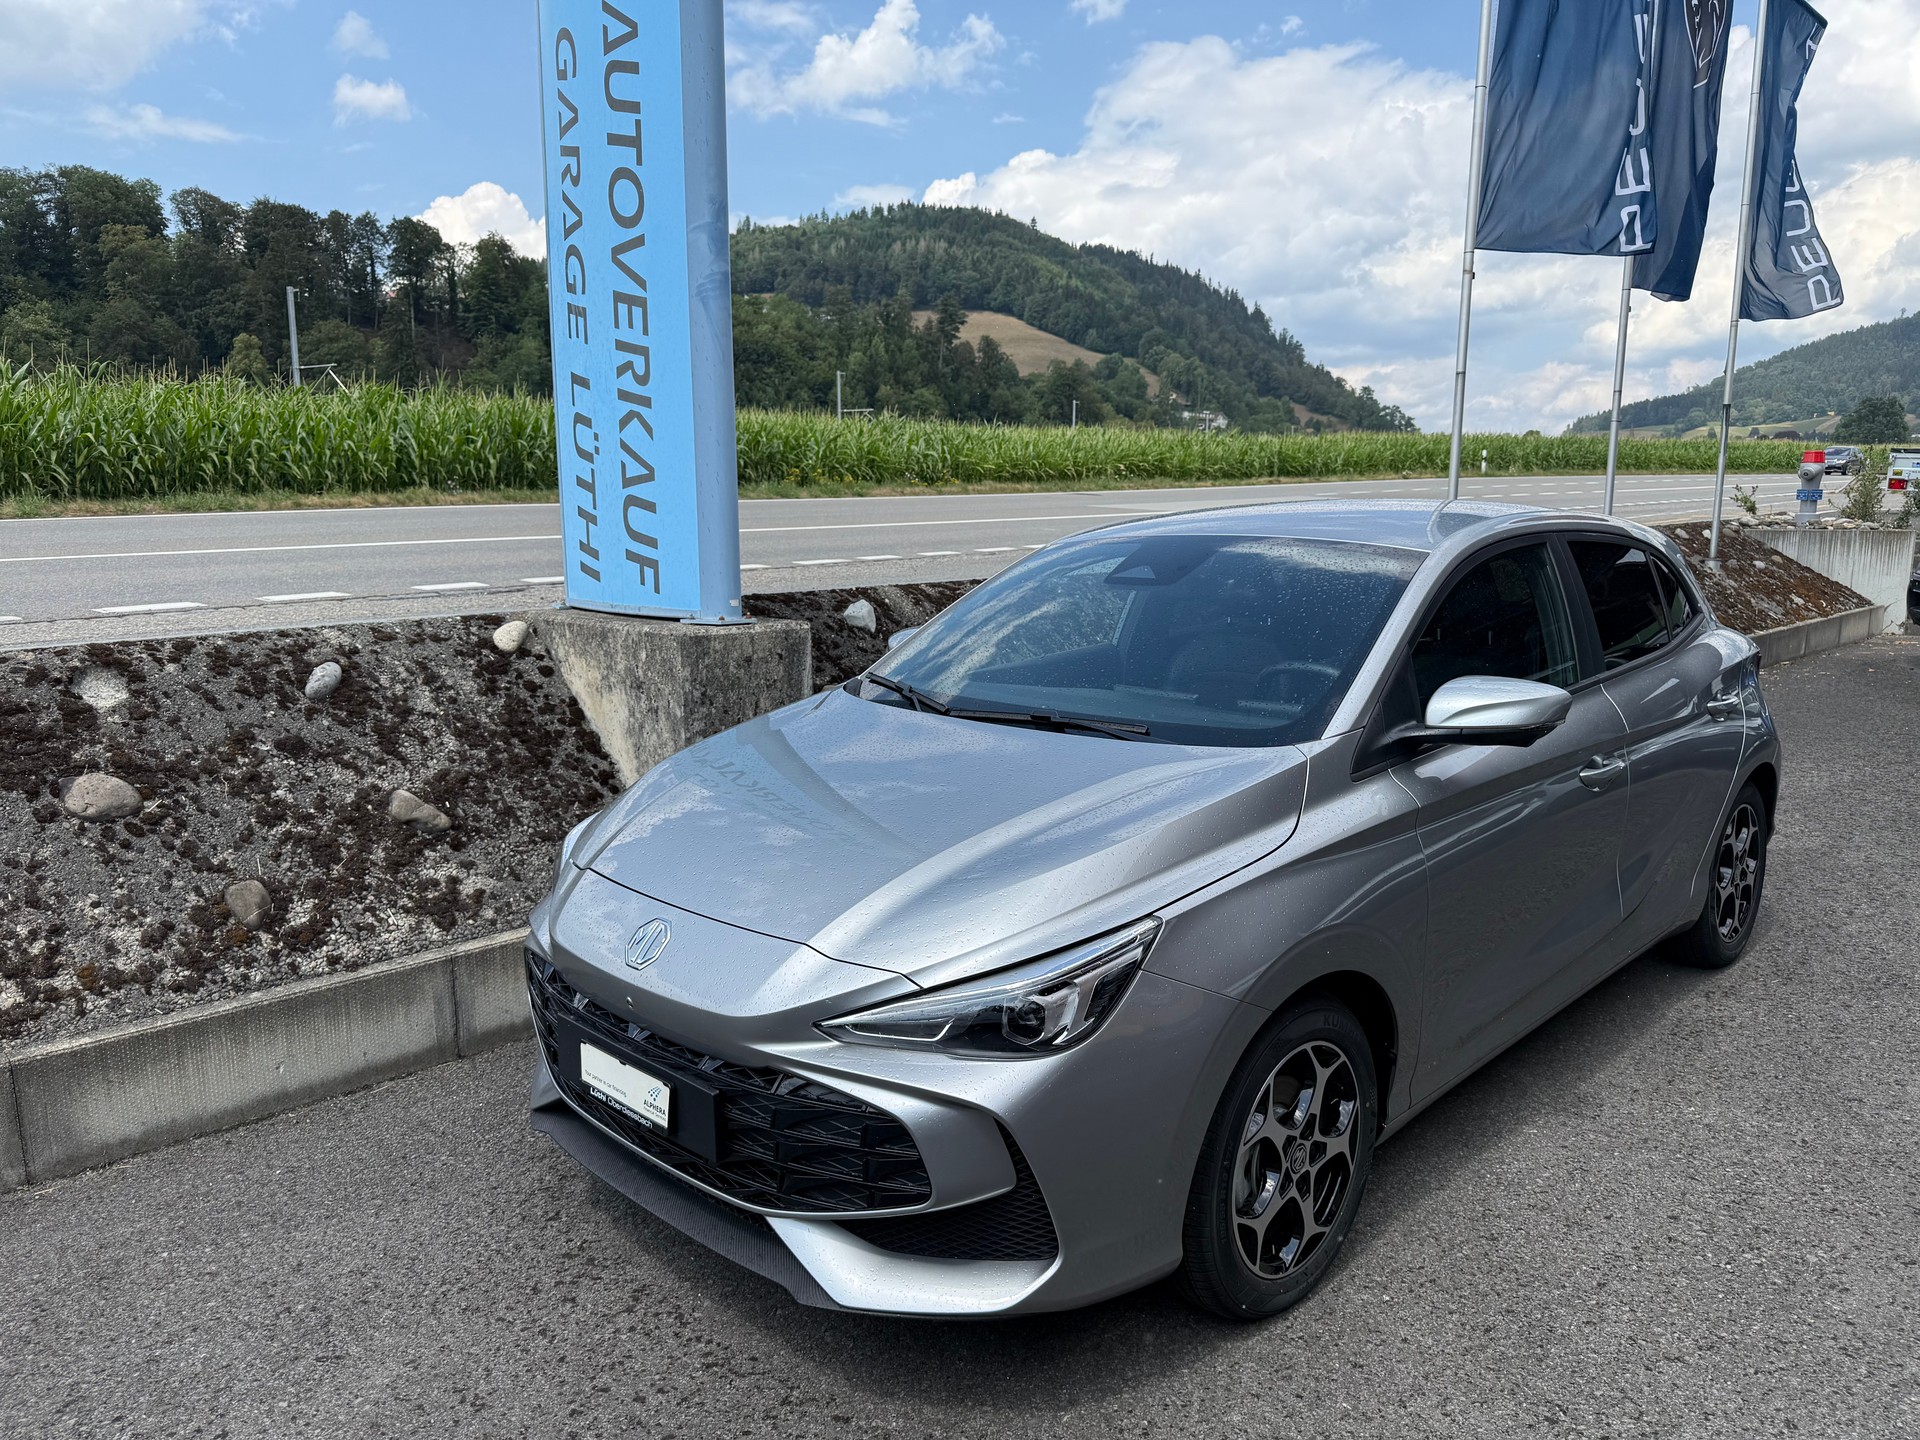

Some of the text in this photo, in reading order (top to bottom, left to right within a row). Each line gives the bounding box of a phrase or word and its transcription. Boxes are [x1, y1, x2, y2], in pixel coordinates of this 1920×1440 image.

[555, 27, 601, 582] GARAGE LÜTHI
[602, 0, 661, 595] AUTOVERKAUF
[626, 919, 671, 969] MG
[643, 1098, 667, 1117] ALPHERA
